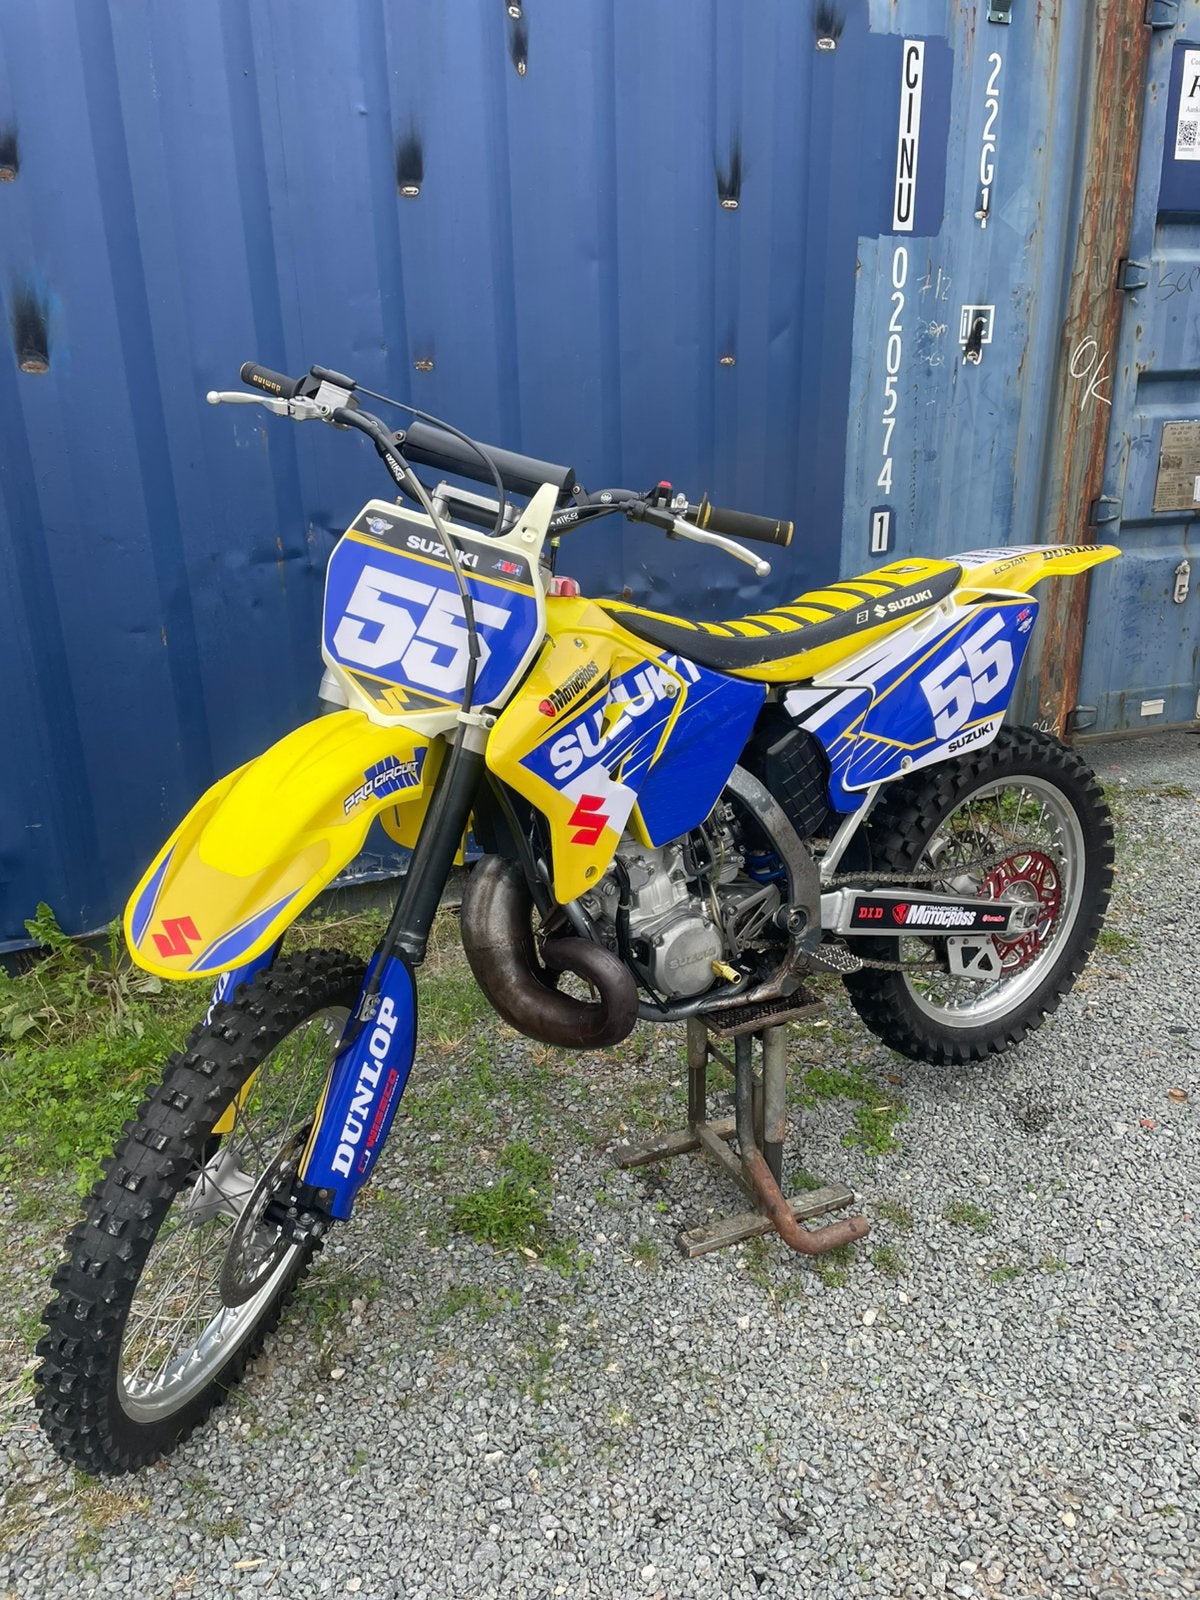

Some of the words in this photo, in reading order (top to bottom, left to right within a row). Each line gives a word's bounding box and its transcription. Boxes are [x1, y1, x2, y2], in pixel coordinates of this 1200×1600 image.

[897, 45, 920, 223] CINU
[980, 52, 1002, 229] 22G1
[877, 246, 908, 495] 020574
[1070, 335, 1112, 411] OK
[876, 515, 886, 550] 1
[333, 564, 511, 694] 55
[887, 589, 933, 613] SUZUKI
[549, 654, 702, 781] SUZUKI
[920, 612, 1014, 740] 55
[948, 722, 994, 753] SUZUKI
[344, 779, 374, 815] PRO
[374, 760, 419, 789] CIRCUIT
[858, 907, 884, 919] DID
[330, 996, 400, 1179] DUNLOP
